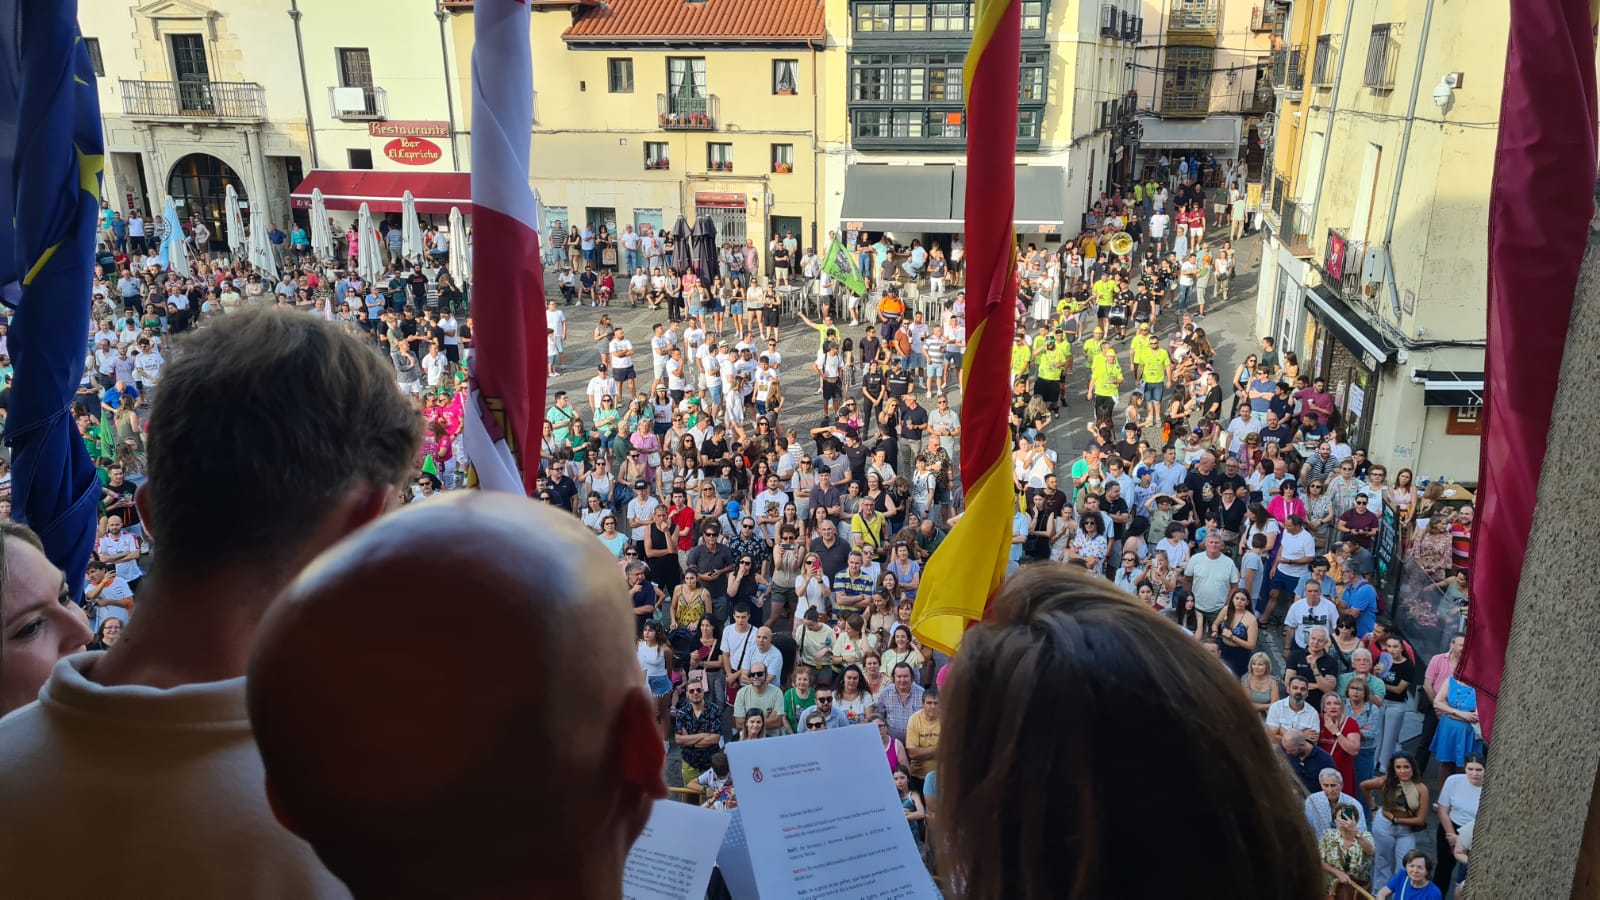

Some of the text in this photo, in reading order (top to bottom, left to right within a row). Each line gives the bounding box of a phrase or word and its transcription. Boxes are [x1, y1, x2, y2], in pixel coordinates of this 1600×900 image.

[370, 123, 447, 135] Restaurante
[401, 138, 421, 148] Bar
[388, 149, 438, 161] El Capricho
